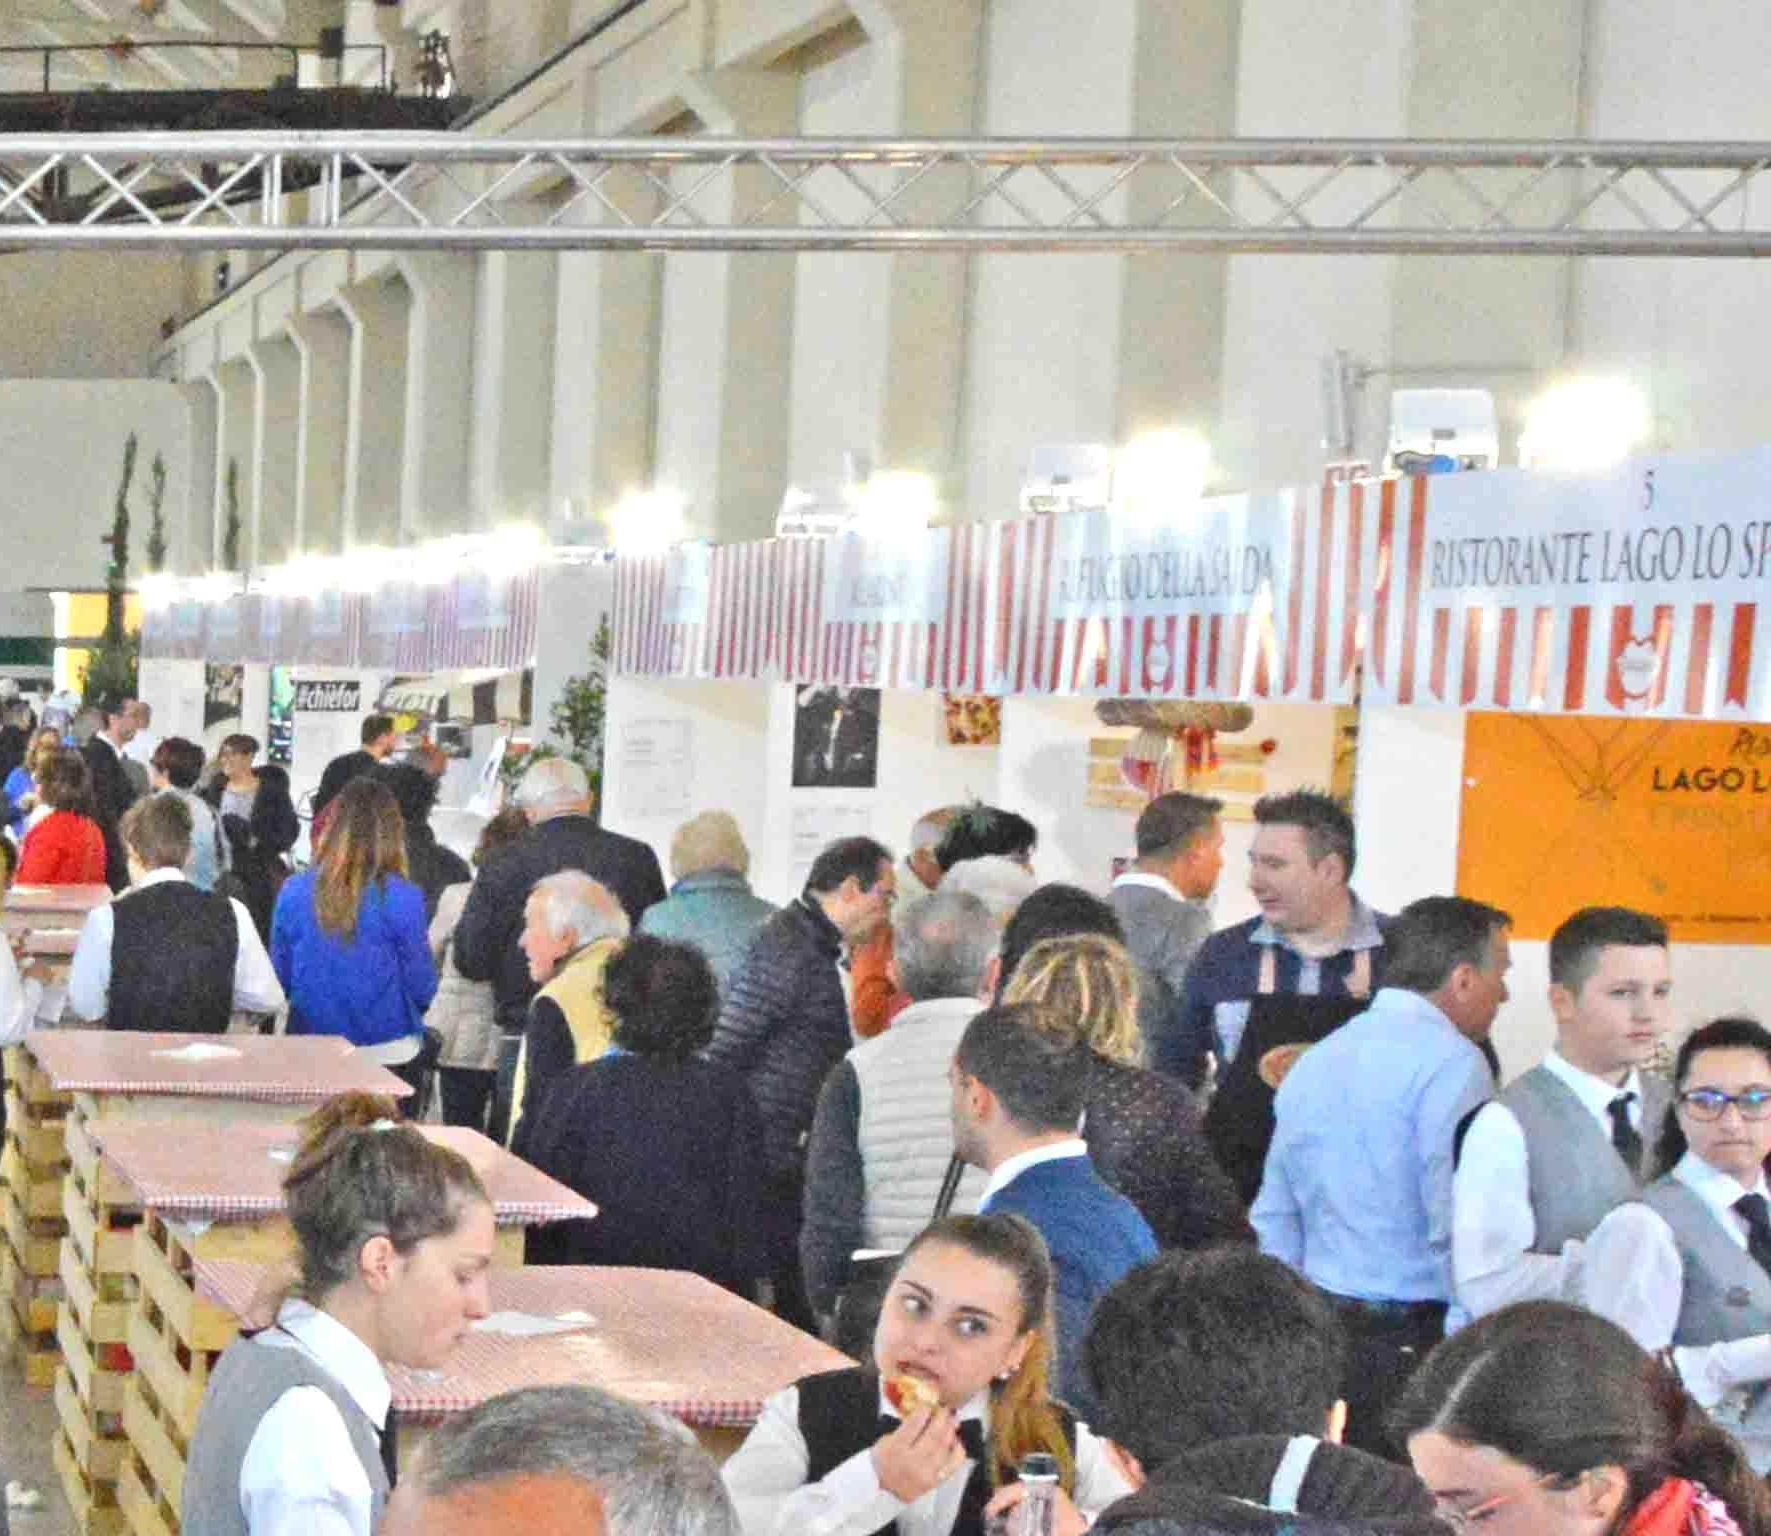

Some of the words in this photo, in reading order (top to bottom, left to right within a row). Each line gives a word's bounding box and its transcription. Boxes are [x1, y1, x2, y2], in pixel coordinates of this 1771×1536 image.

[1431, 531, 1593, 589] RISTORANTE
[1599, 526, 1684, 583] LAGO
[1691, 523, 1732, 580] LO
[1651, 766, 1746, 792] LAGO
